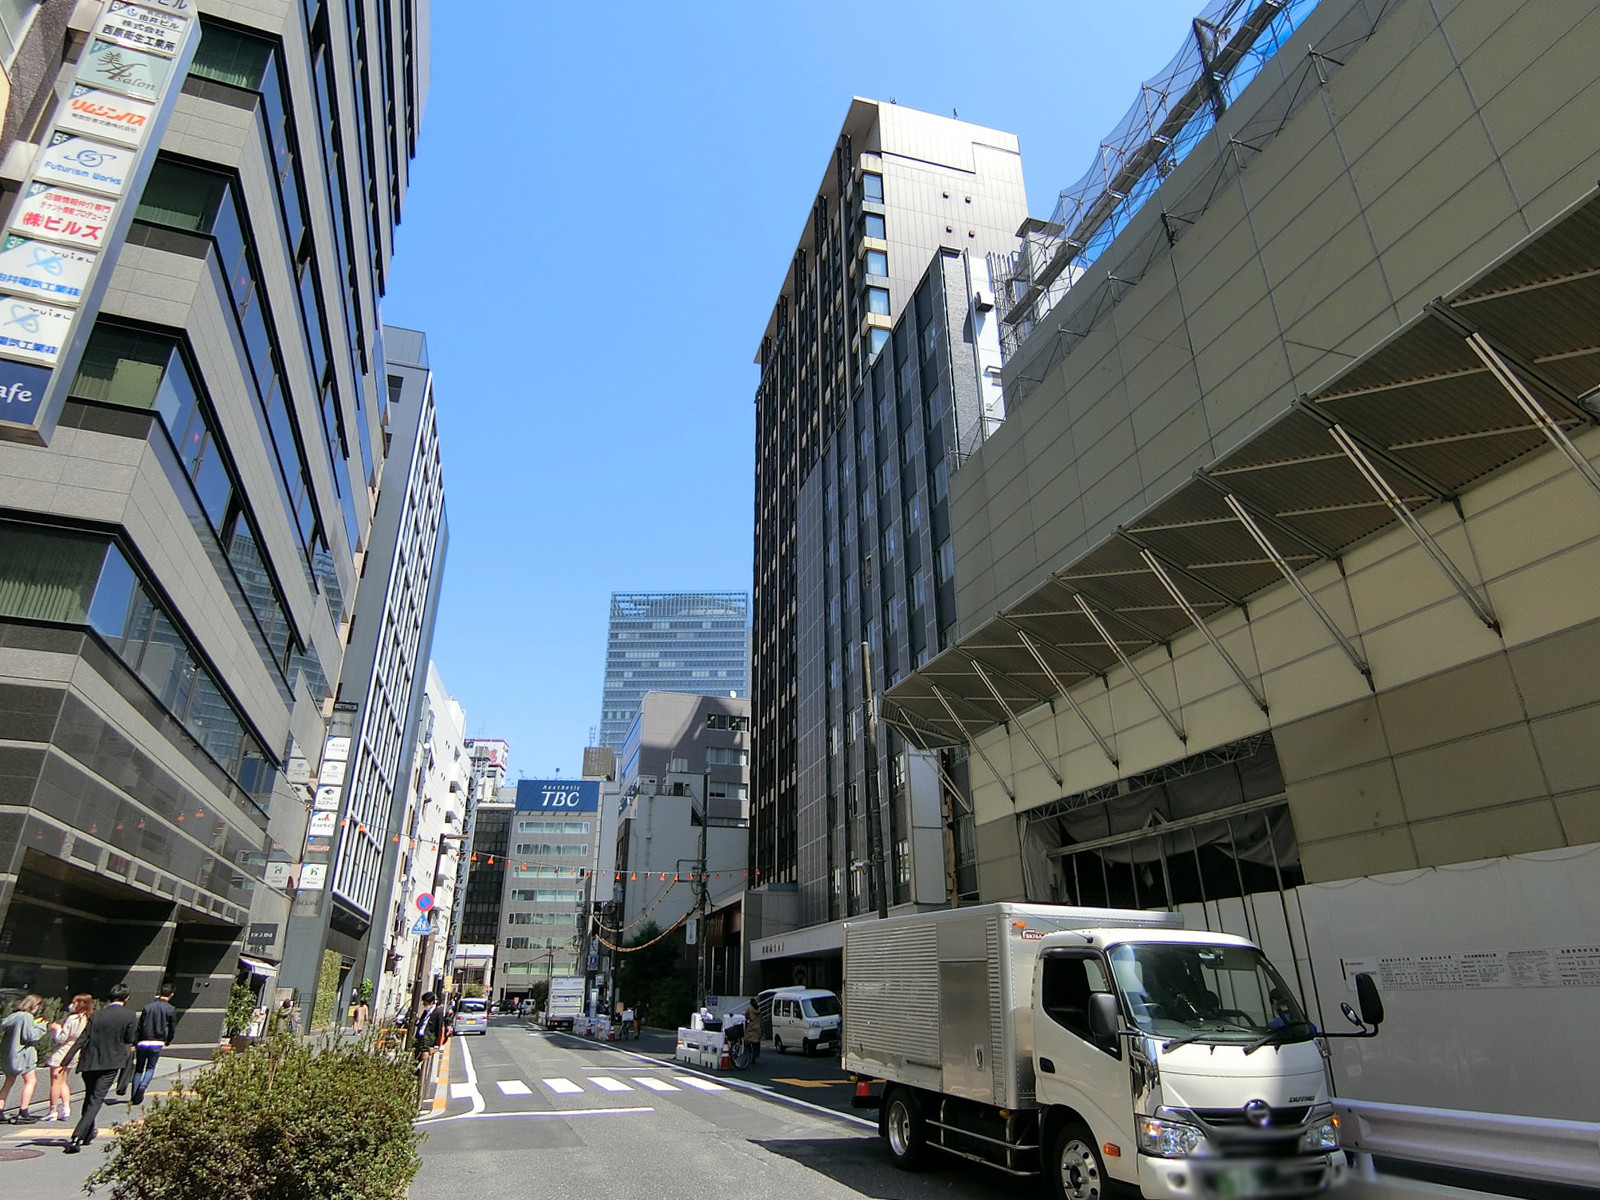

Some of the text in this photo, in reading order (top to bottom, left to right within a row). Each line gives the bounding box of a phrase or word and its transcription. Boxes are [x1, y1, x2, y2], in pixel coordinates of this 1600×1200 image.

[122, 20, 165, 37] 株式会社
[71, 99, 147, 126] リムジンバス
[44, 161, 90, 177] Futurism
[30, 184, 47, 195] 4F
[7, 236, 24, 249] 3F
[541, 791, 580, 807] TBC
